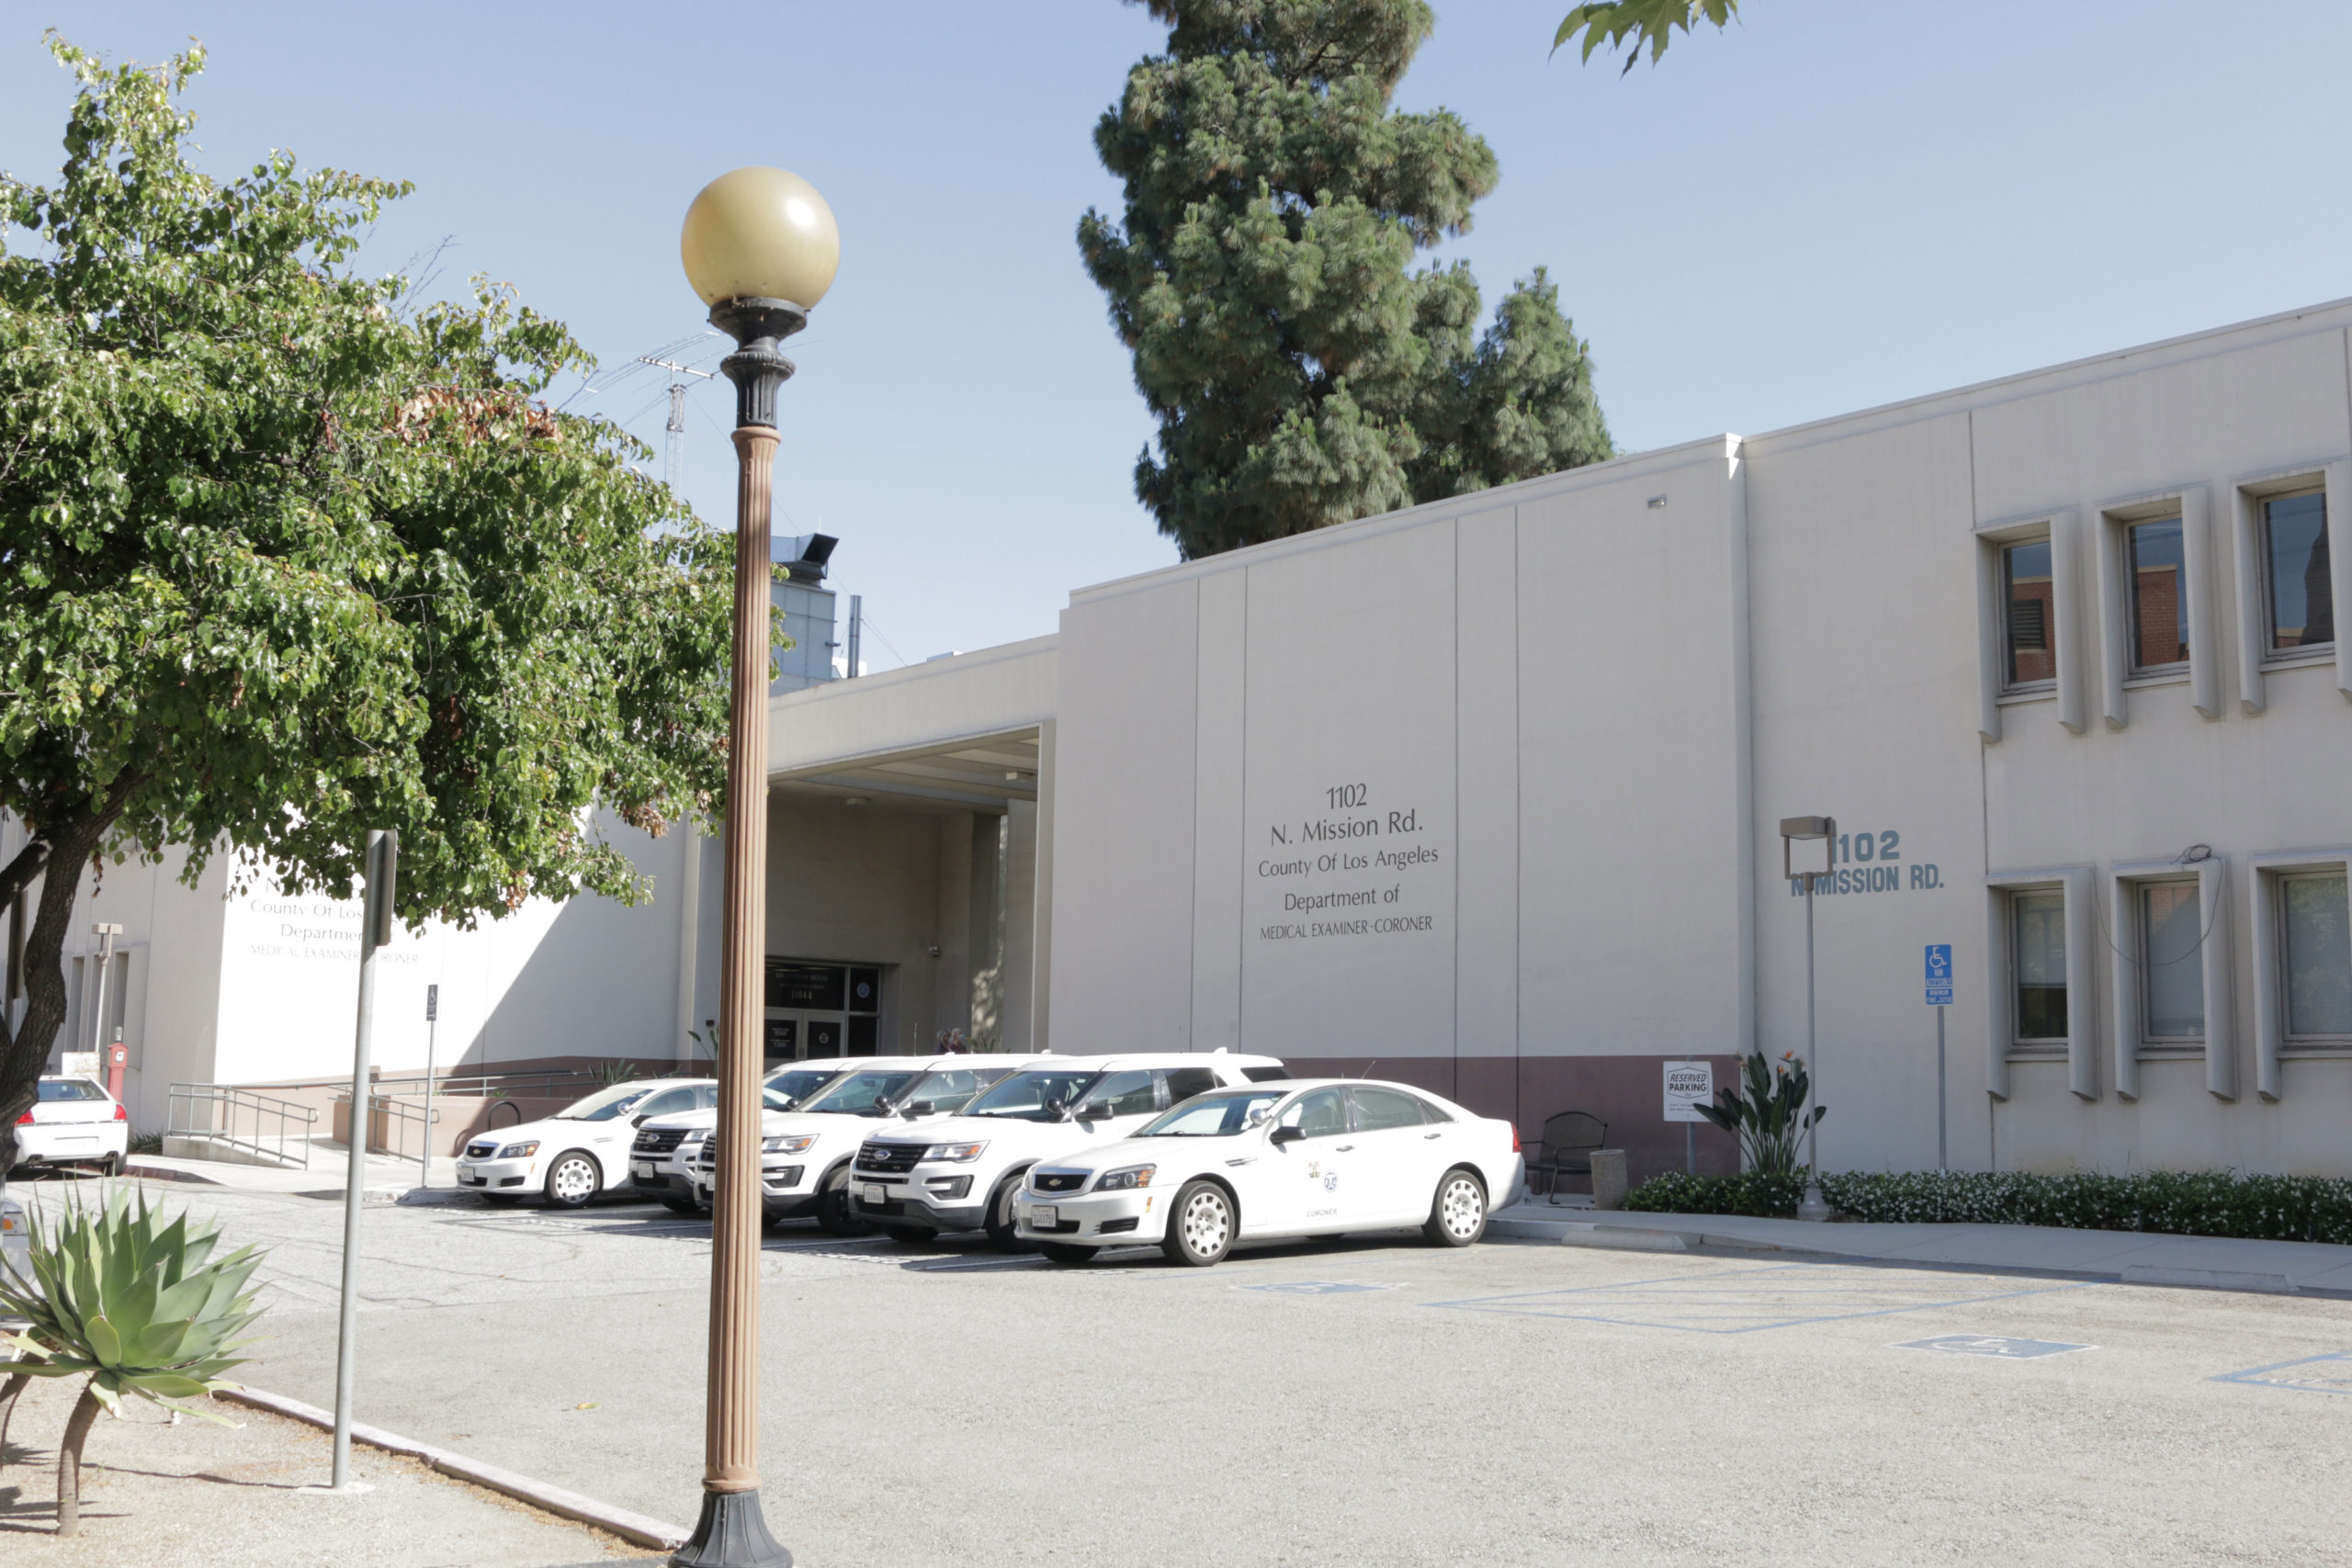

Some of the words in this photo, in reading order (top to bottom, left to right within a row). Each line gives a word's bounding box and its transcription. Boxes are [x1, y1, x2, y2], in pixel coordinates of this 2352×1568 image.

[1326, 783, 1368, 809] 1102
[1272, 823, 1293, 846] N.
[1302, 817, 1378, 843] Mission
[1388, 808, 1423, 834] Rd.
[1259, 860, 1312, 878] County
[1317, 852, 1338, 872] Of
[1343, 853, 1368, 870] Los
[1374, 845, 1439, 871] Angeles
[1815, 866, 1899, 897] MISSION
[1910, 863, 1945, 890] RD.
[1284, 888, 1376, 915] Department
[1384, 884, 1400, 903] of
[313, 904, 332, 918] Of
[339, 906, 362, 920] Los
[280, 923, 363, 942] Departme
[1260, 924, 1307, 940] MEDICAL
[1311, 916, 1432, 937] EXAMINER-CORONER
[250, 944, 299, 958] MEDICAL
[1668, 1083, 1707, 1092] PARKING
[1669, 1073, 1707, 1083] RESERVED
[1306, 1208, 1338, 1218] CORONER
